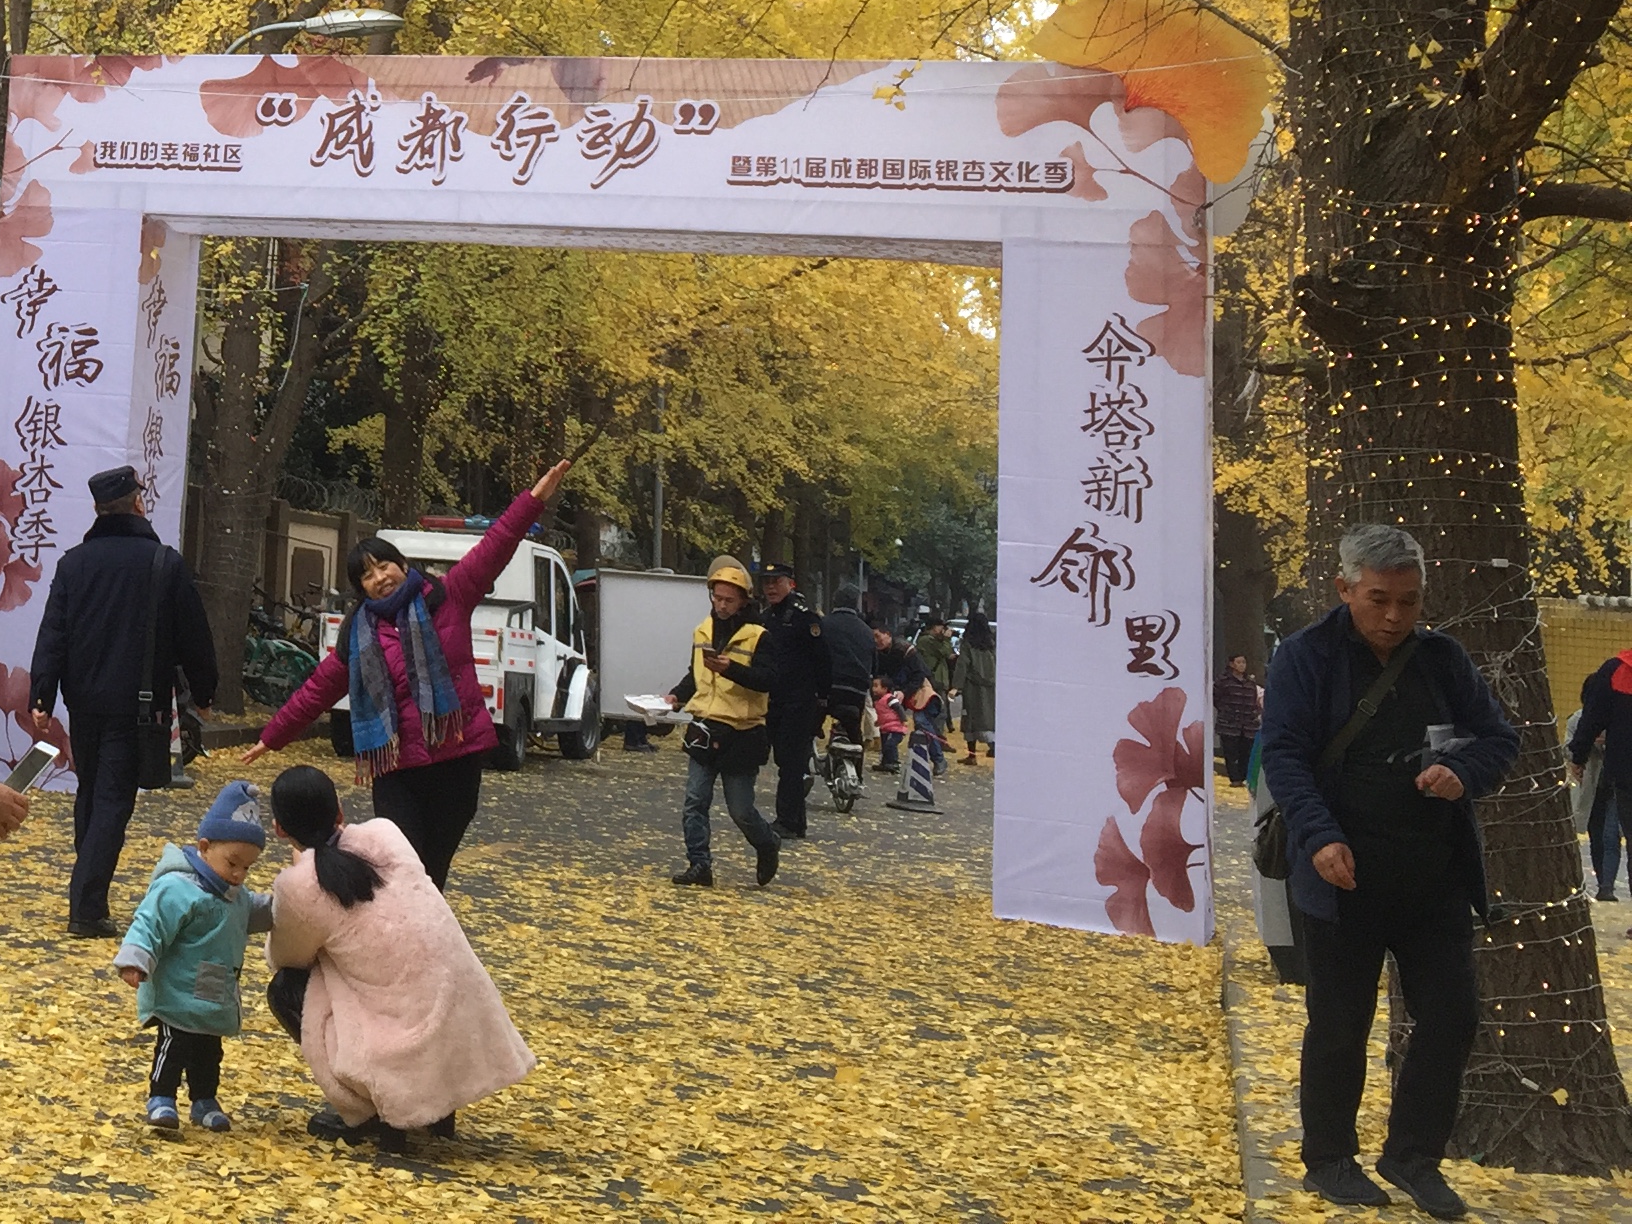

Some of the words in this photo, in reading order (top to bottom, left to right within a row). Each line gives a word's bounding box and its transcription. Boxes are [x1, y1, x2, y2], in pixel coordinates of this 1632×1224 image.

[97, 141, 243, 167] 我们的幸福社区
[729, 155, 1072, 186] 暨第11届成都国际银杏文化季
[2, 265, 104, 566] 幸福银杏季
[141, 274, 181, 525] 幸福银杏
[1031, 313, 1181, 680] 伞塔新邻里
